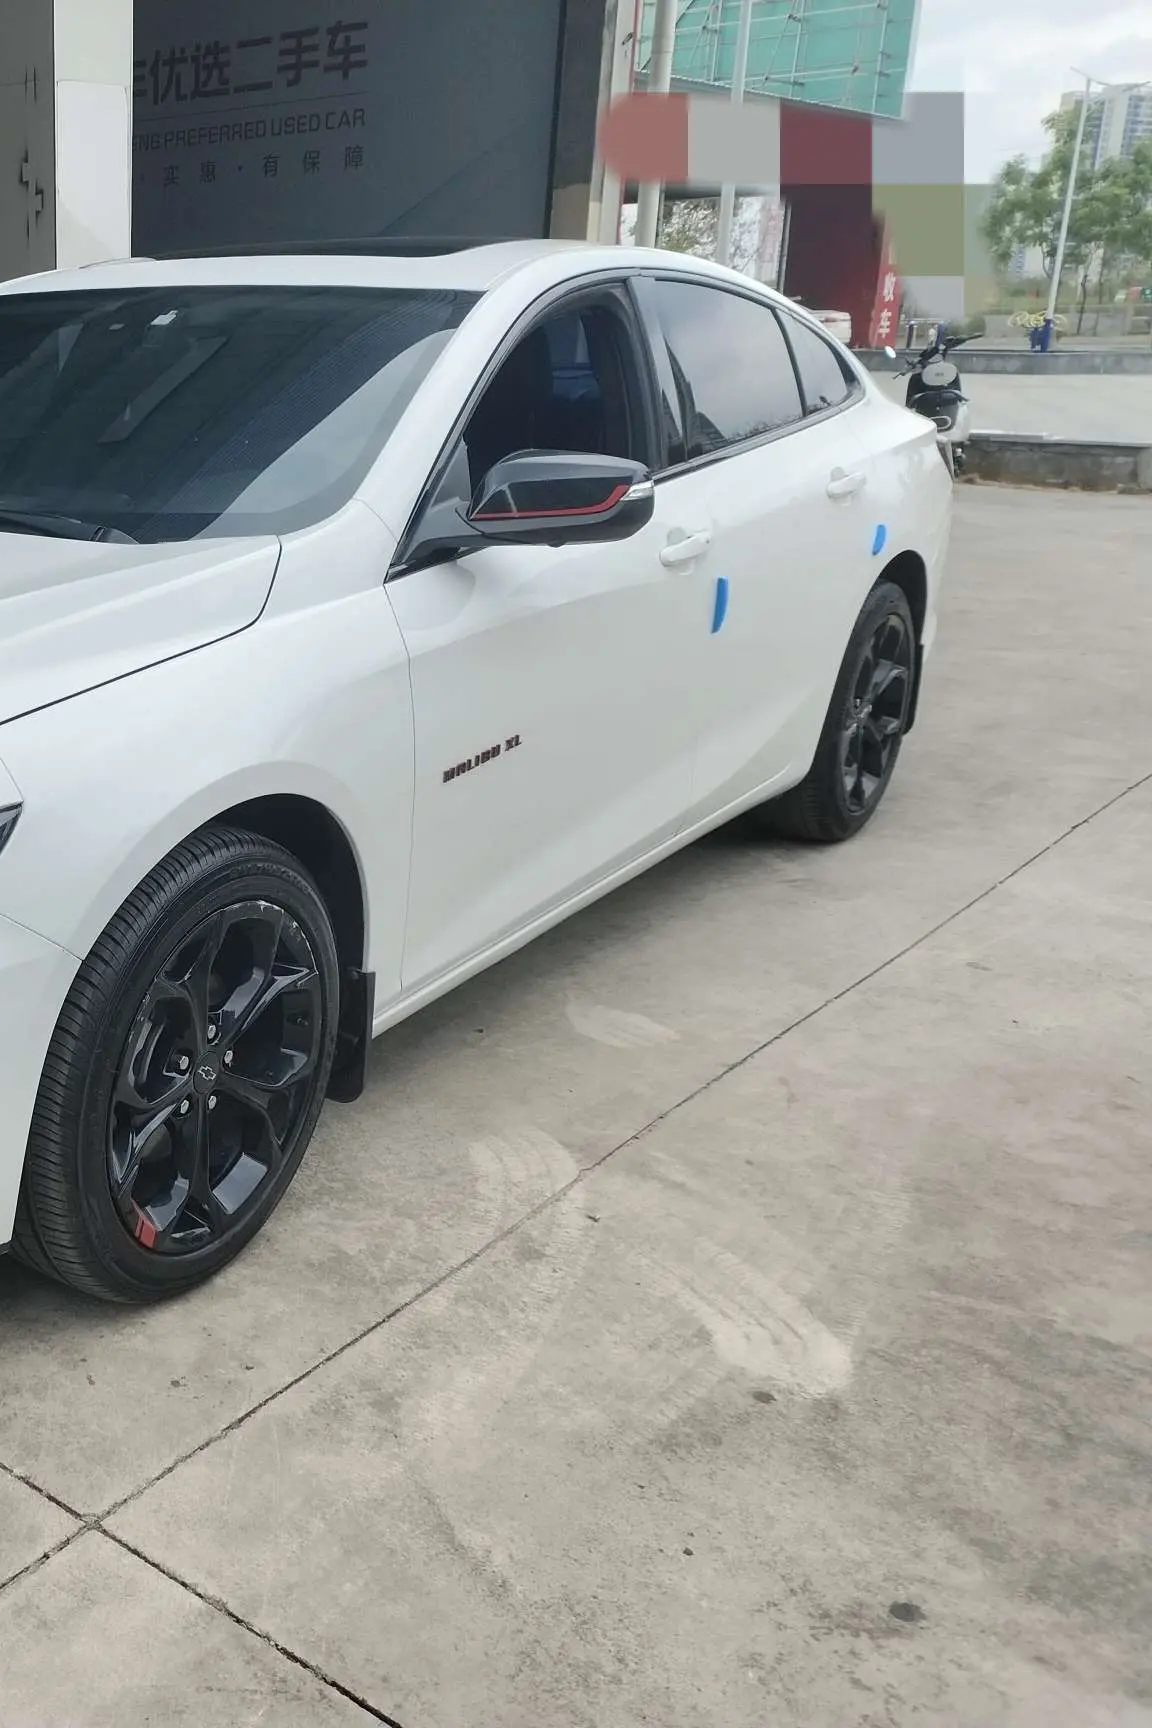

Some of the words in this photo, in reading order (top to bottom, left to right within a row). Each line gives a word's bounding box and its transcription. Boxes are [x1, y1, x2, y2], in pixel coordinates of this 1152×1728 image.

[164, 119, 266, 148] PREFERRED
[271, 113, 320, 137] USED
[325, 108, 366, 131] CAR
[505, 734, 522, 751] XL
